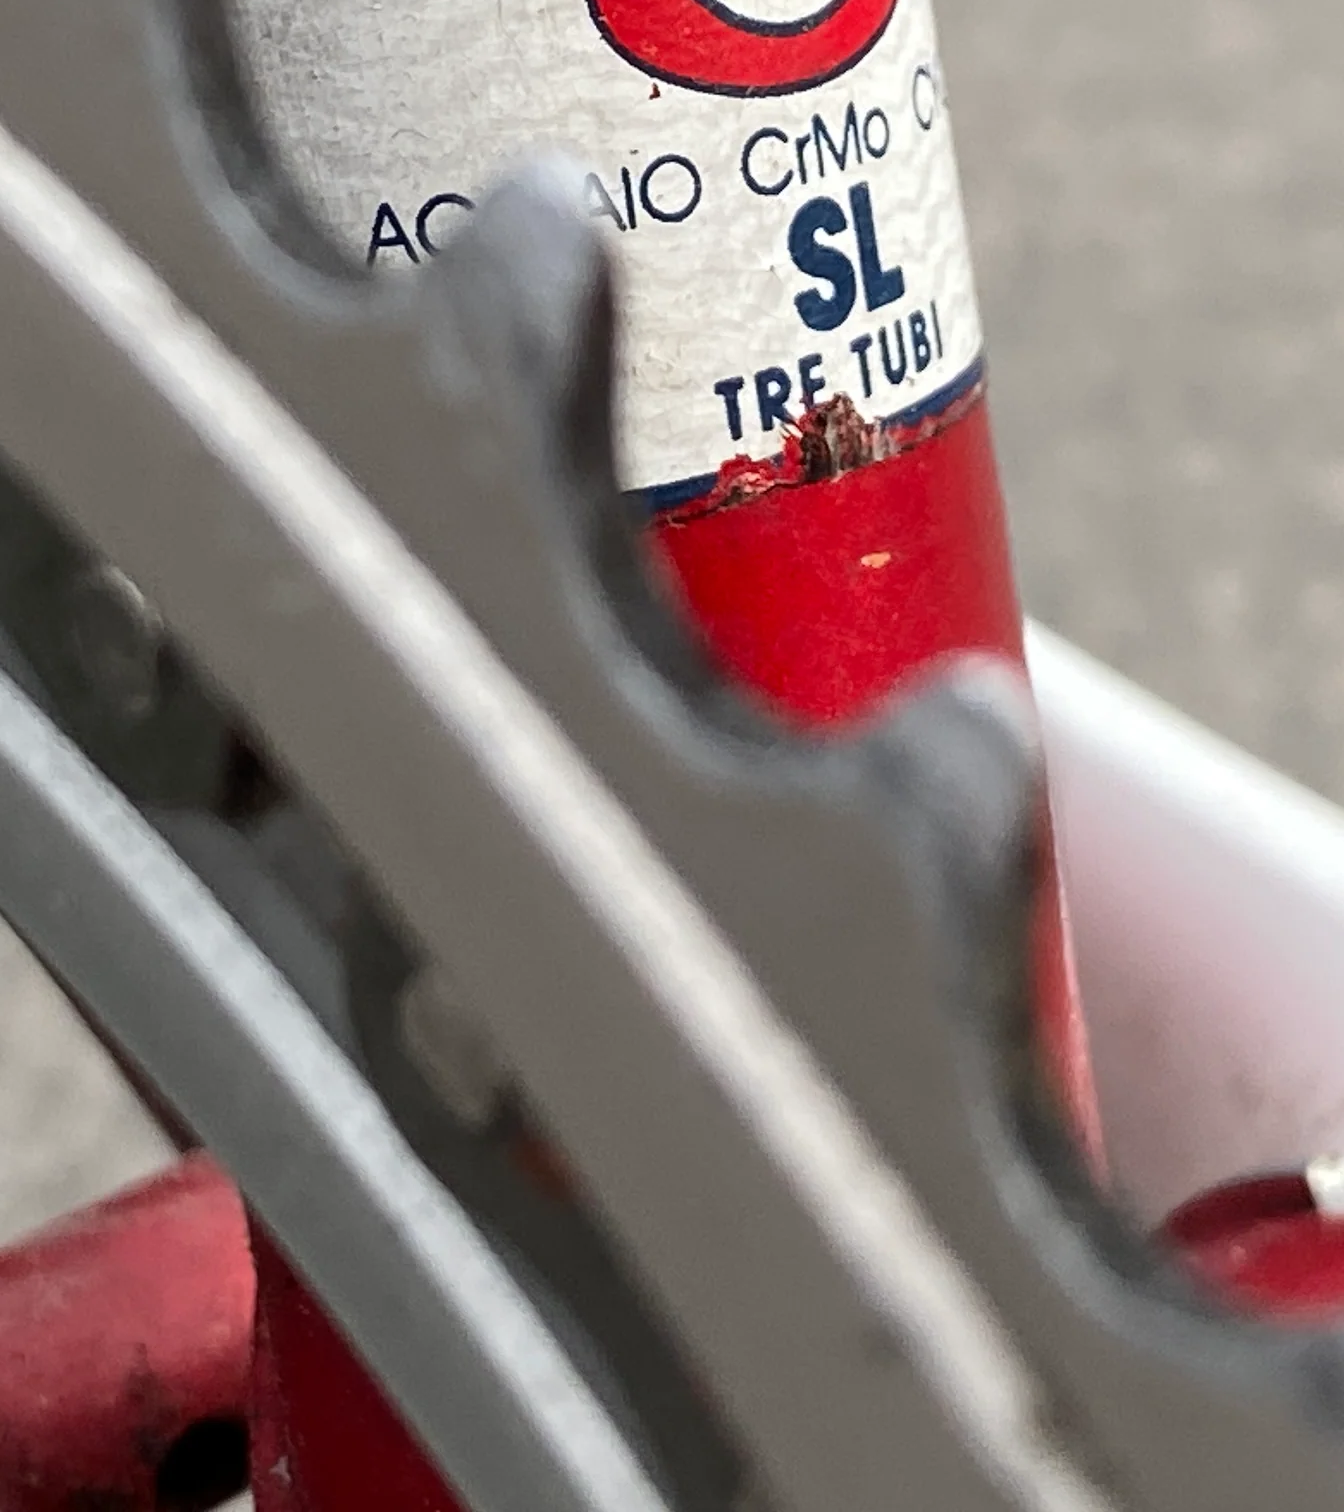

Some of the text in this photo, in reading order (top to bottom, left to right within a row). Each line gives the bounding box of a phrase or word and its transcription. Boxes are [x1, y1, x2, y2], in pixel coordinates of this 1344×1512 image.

[365, 153, 702, 266] ACAIO
[740, 100, 890, 196] CrMo
[787, 180, 905, 332] SL
[849, 299, 944, 399] TUBI
